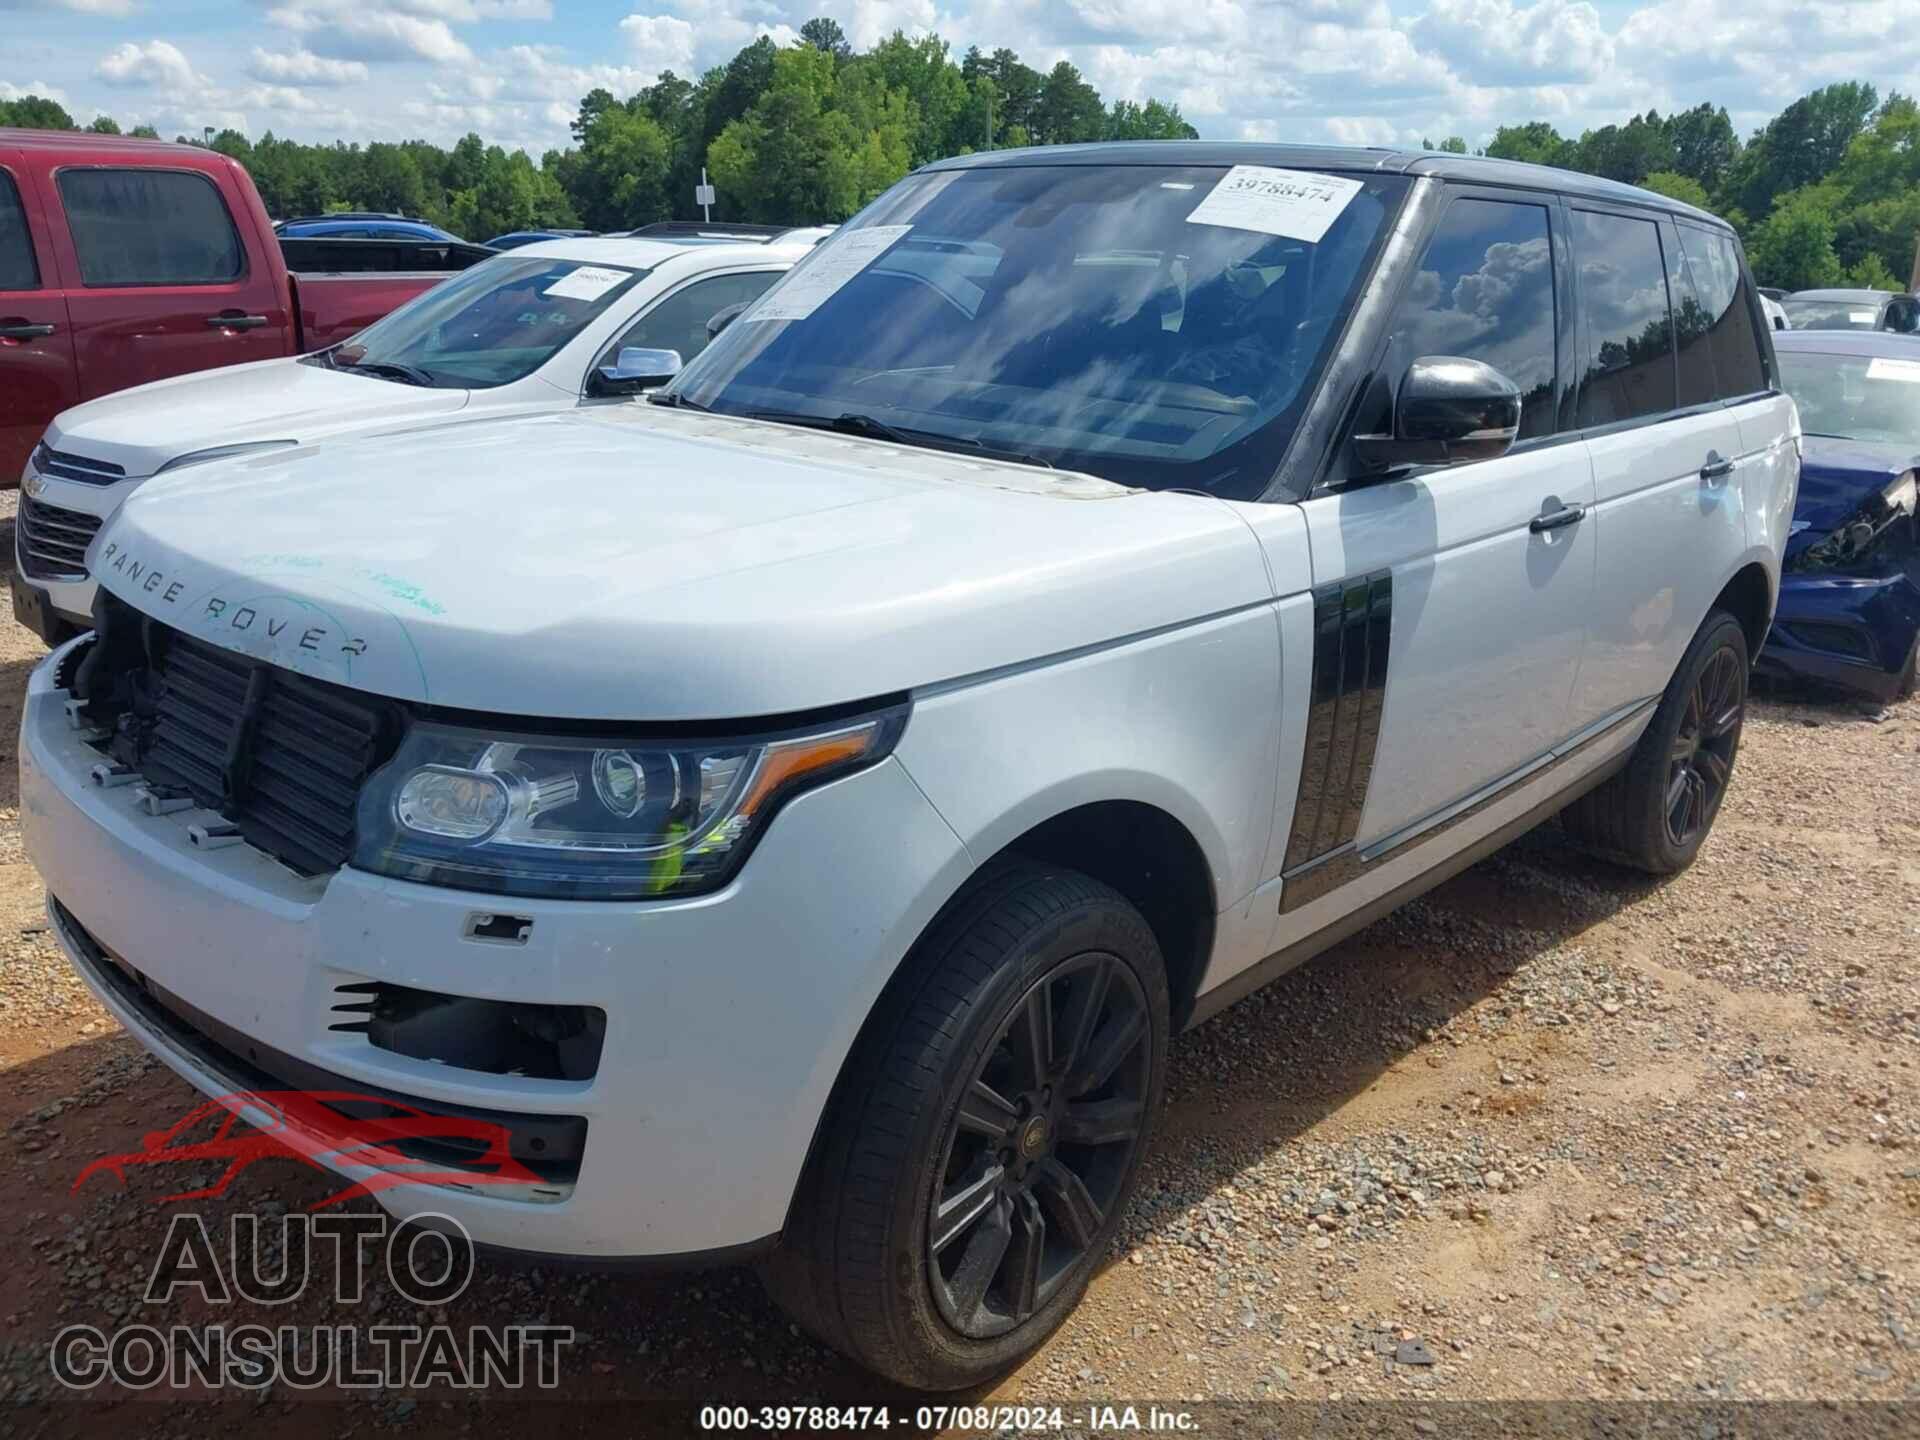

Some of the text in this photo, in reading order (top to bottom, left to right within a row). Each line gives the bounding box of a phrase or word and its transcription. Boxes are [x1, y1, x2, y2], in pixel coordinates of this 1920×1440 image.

[1229, 177, 1336, 202] 39788474
[103, 542, 367, 656] RANGE ROVER
